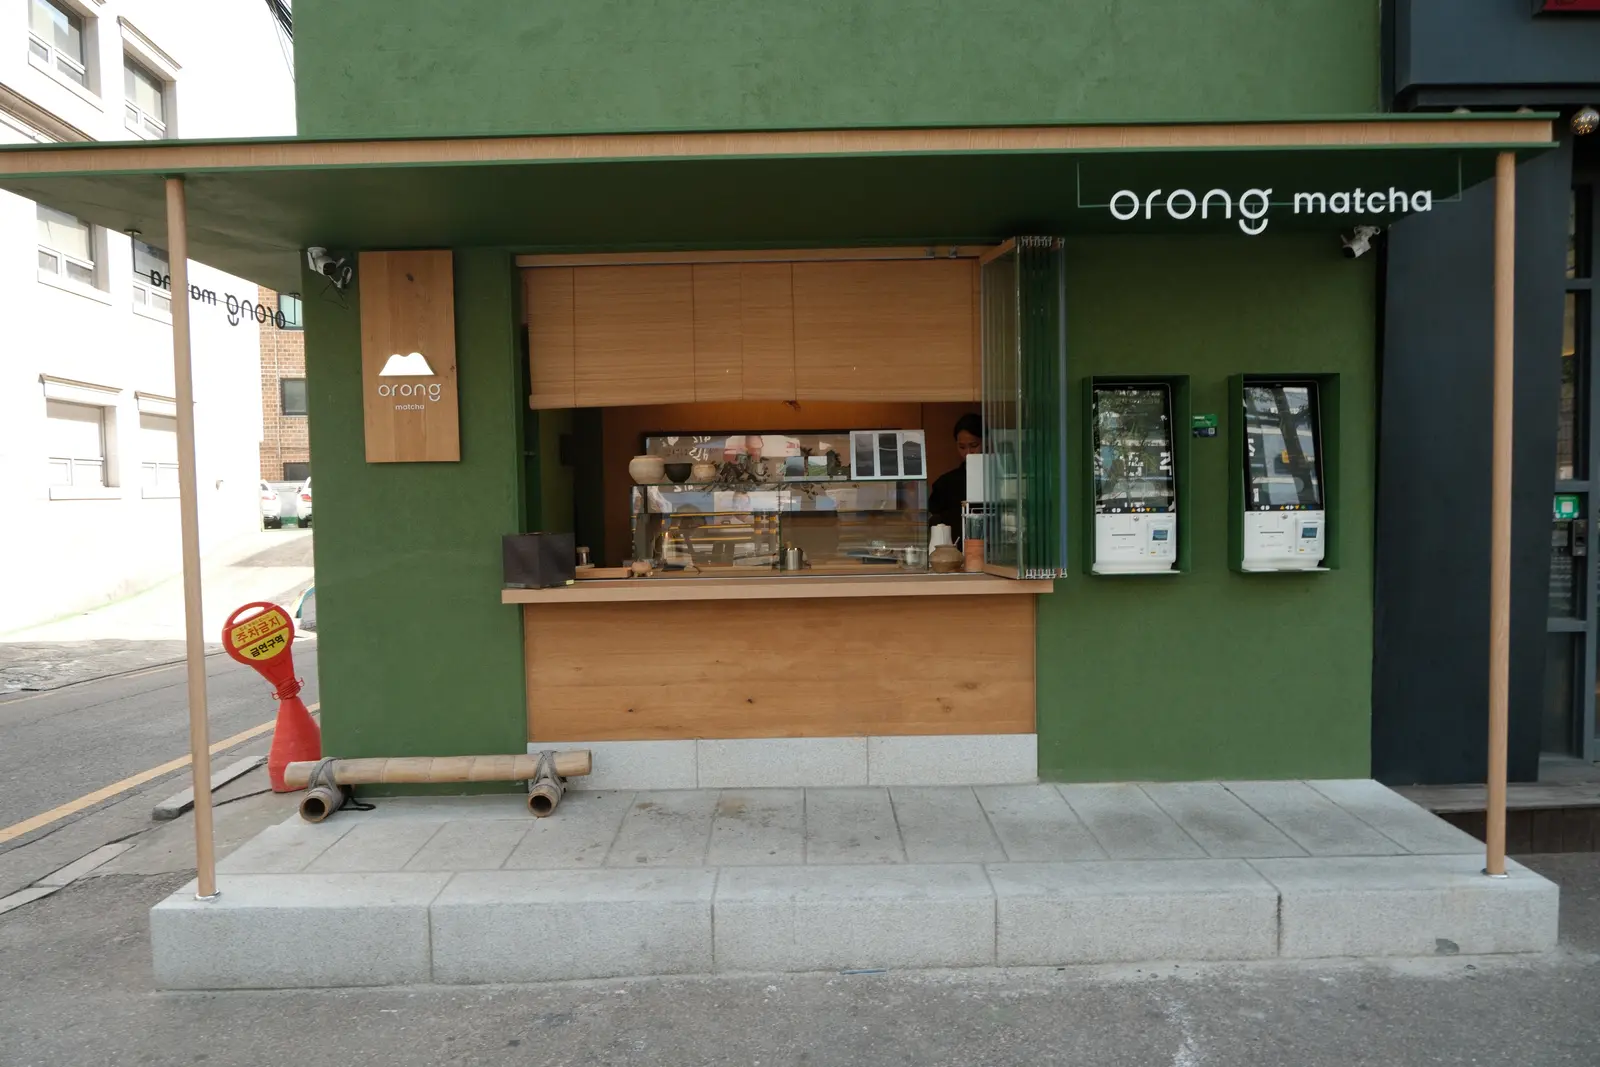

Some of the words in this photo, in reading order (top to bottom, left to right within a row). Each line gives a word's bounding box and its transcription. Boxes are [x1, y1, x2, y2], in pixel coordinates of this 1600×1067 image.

[1109, 188, 1273, 235] orong
[1293, 186, 1433, 214] matcha
[378, 383, 442, 402] orong
[395, 403, 425, 411] matcha
[236, 615, 281, 643] 주차금지
[250, 634, 285, 658] 금연구역
